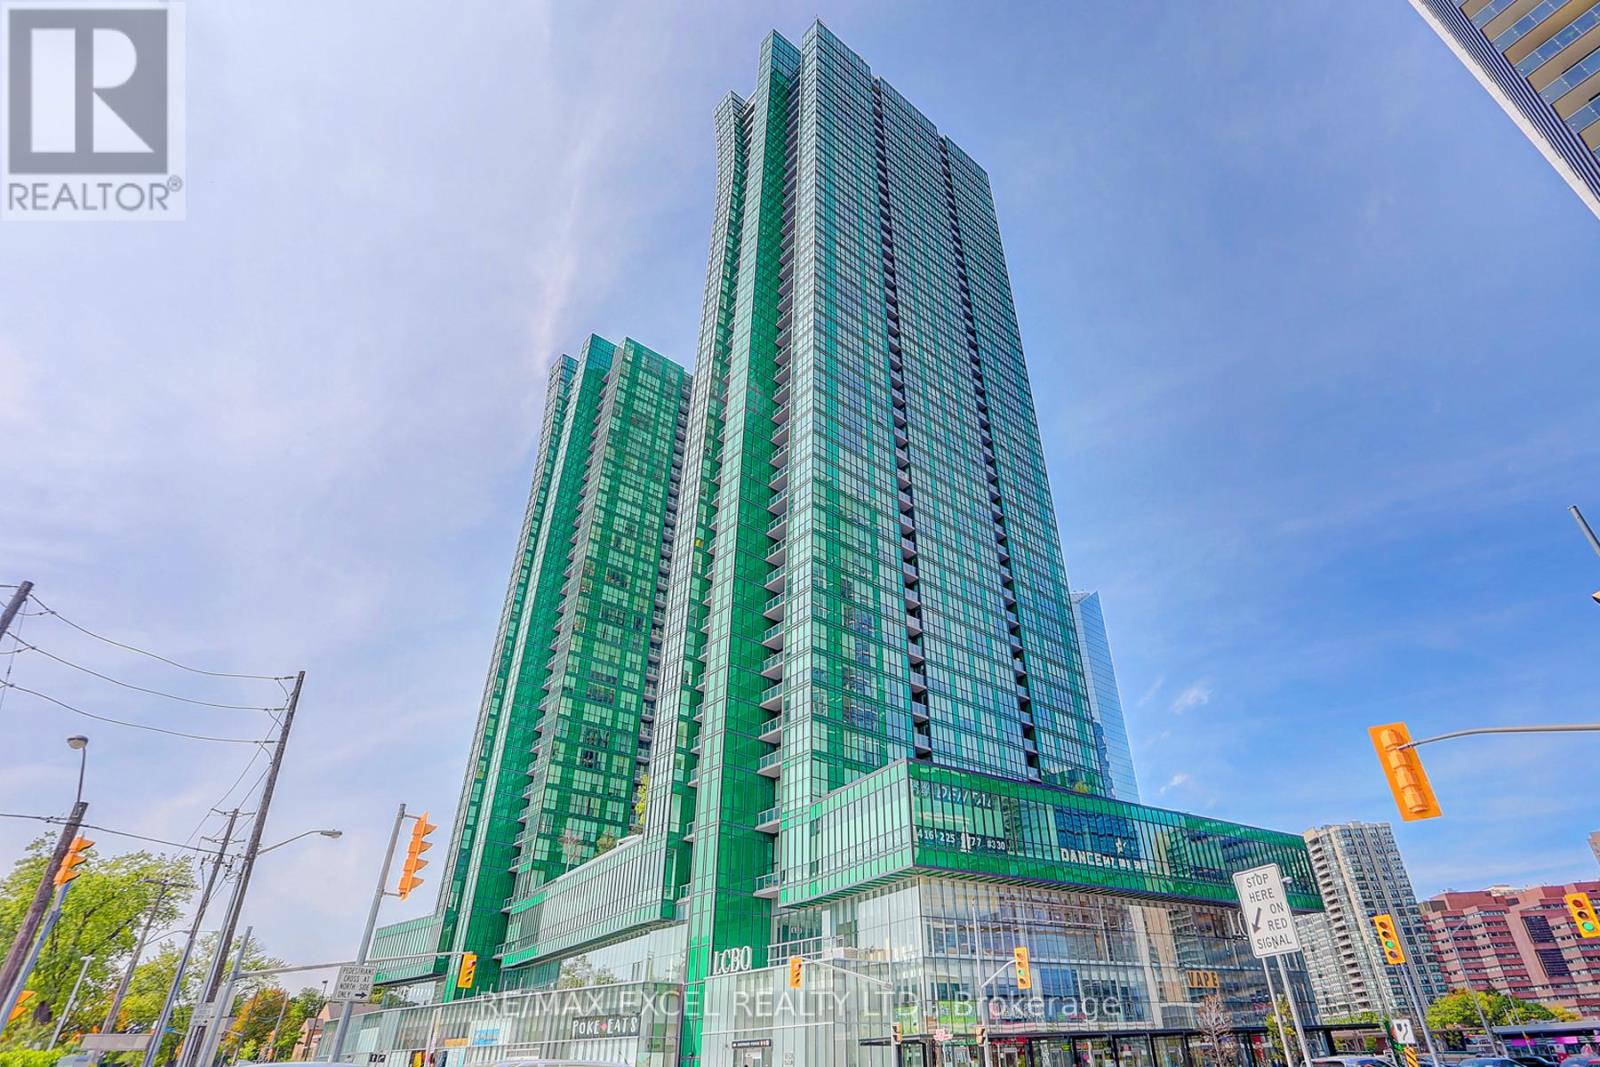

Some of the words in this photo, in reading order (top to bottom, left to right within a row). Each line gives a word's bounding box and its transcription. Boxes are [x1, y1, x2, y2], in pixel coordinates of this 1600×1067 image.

[939, 831, 956, 844] 225
[1246, 873, 1269, 888] STOP
[1248, 888, 1275, 903] HERE
[1269, 902, 1284, 914] ON
[1267, 917, 1288, 931] RED
[1257, 934, 1292, 949] SIGNAL
[713, 945, 752, 975] LCBO
[343, 974, 360, 983] CROSS
[363, 975, 371, 983] AT
[1187, 971, 1218, 987] VAPE
[336, 990, 351, 998] ONLY
[572, 1019, 600, 1039] POKE
[606, 1016, 638, 1034] EATS
